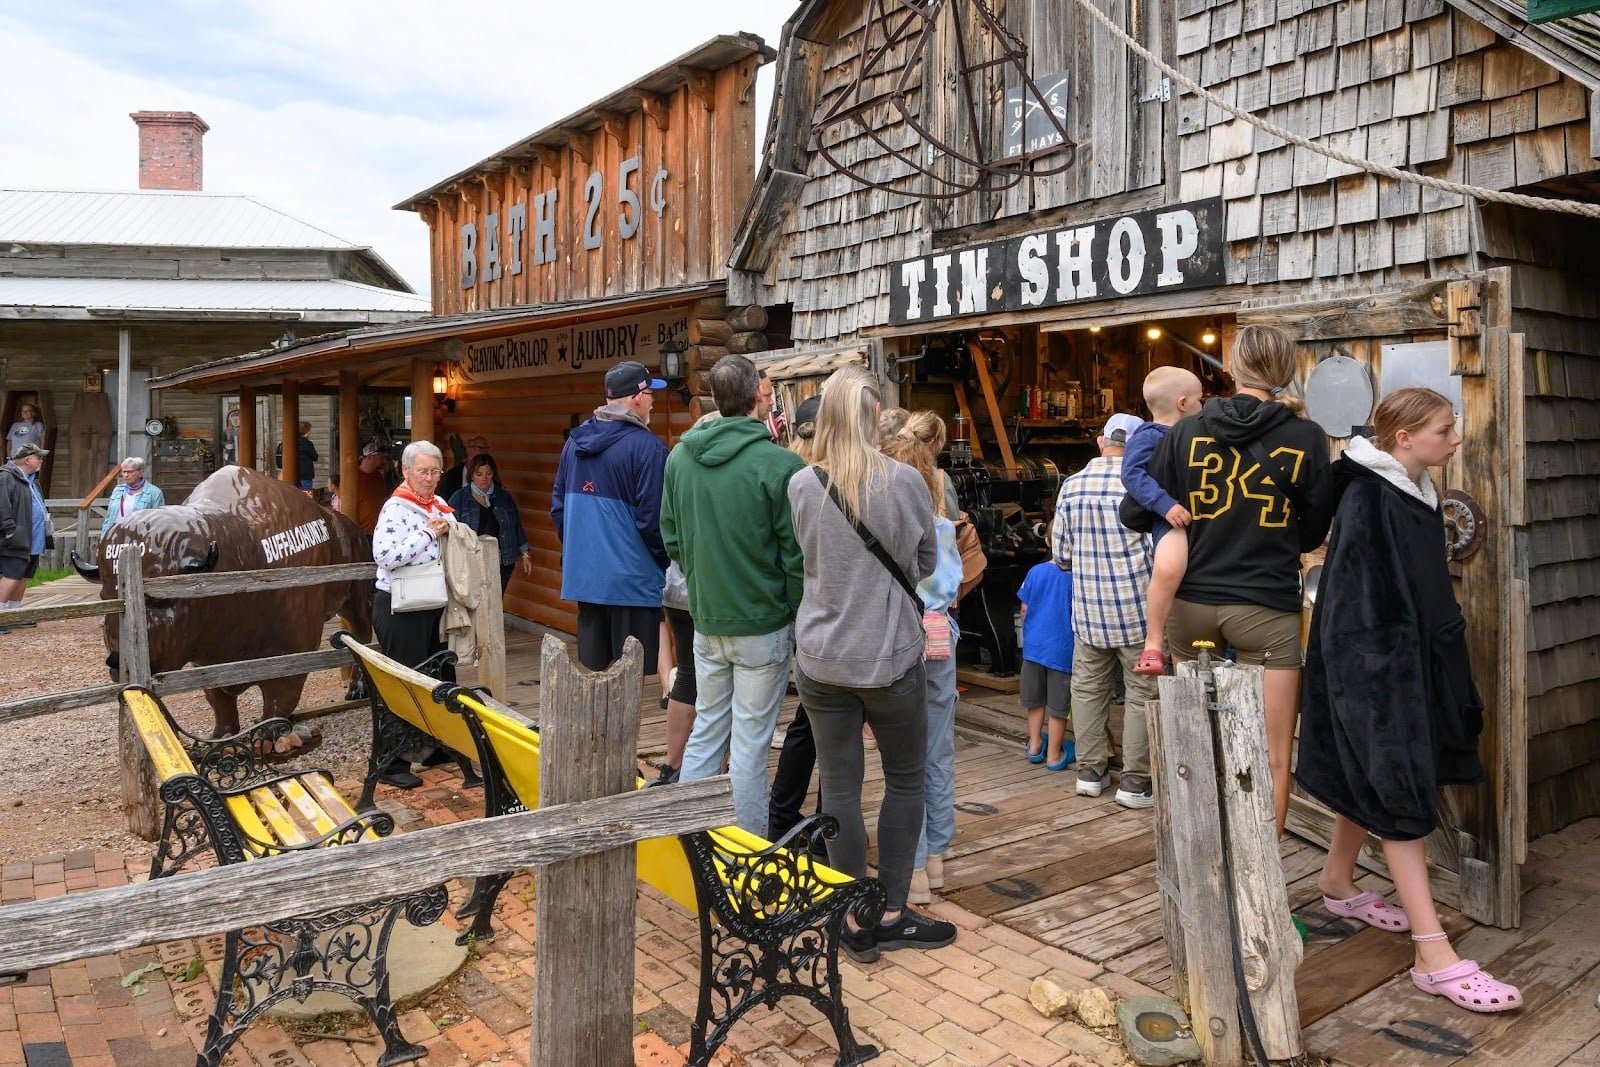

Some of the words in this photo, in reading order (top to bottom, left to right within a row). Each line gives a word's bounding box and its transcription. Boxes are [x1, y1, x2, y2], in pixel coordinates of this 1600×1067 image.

[1049, 92, 1059, 106] S
[1030, 131, 1063, 150] HAYS
[460, 187, 558, 290] BATH
[583, 156, 668, 251] 25¢
[901, 247, 989, 320] TIN
[1017, 209, 1200, 306] SHOP
[467, 343, 505, 374] SHAVING
[506, 338, 549, 370] PARLOR
[570, 323, 640, 370] LAUNDRY
[657, 317, 688, 345] BATH
[1188, 436, 1305, 528] 34
